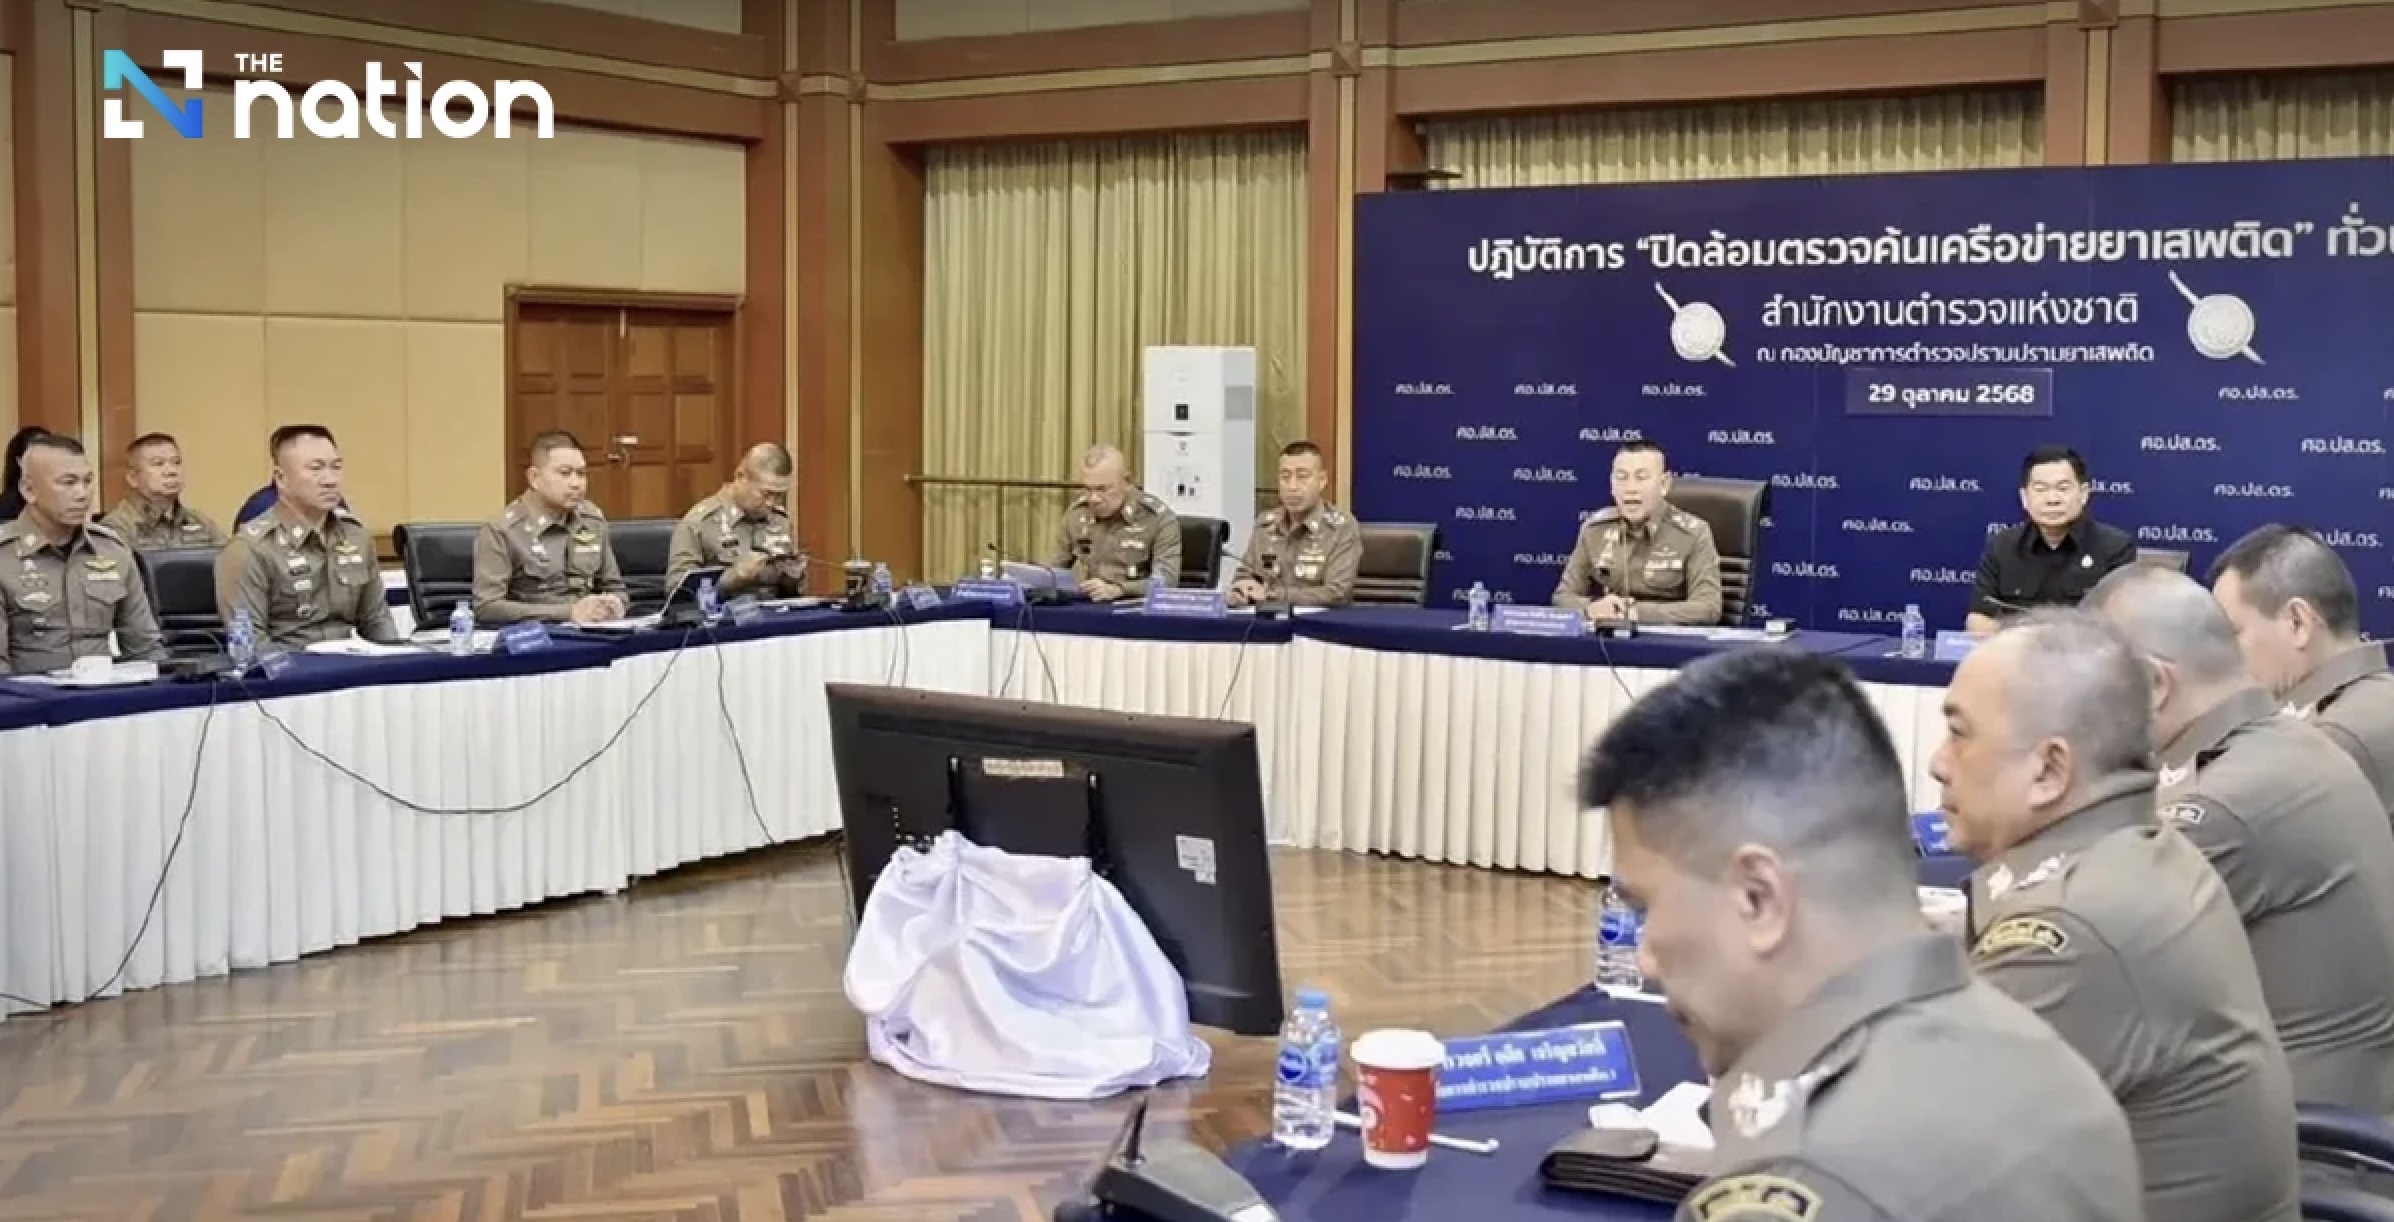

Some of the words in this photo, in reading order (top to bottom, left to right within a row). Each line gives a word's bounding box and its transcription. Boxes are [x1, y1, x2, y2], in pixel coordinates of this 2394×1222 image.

[2328, 202, 2394, 256] ทั่ว
[1762, 292, 2138, 326] สำนักงานตำรวจแห่งชาติ
[1782, 342, 2154, 364] กองบัญชาการตำรวจปราบปรามยาเสพติด
[1870, 384, 1896, 402] 29
[1902, 388, 1970, 408] ตุลาคม
[1976, 384, 2034, 402] 2568
